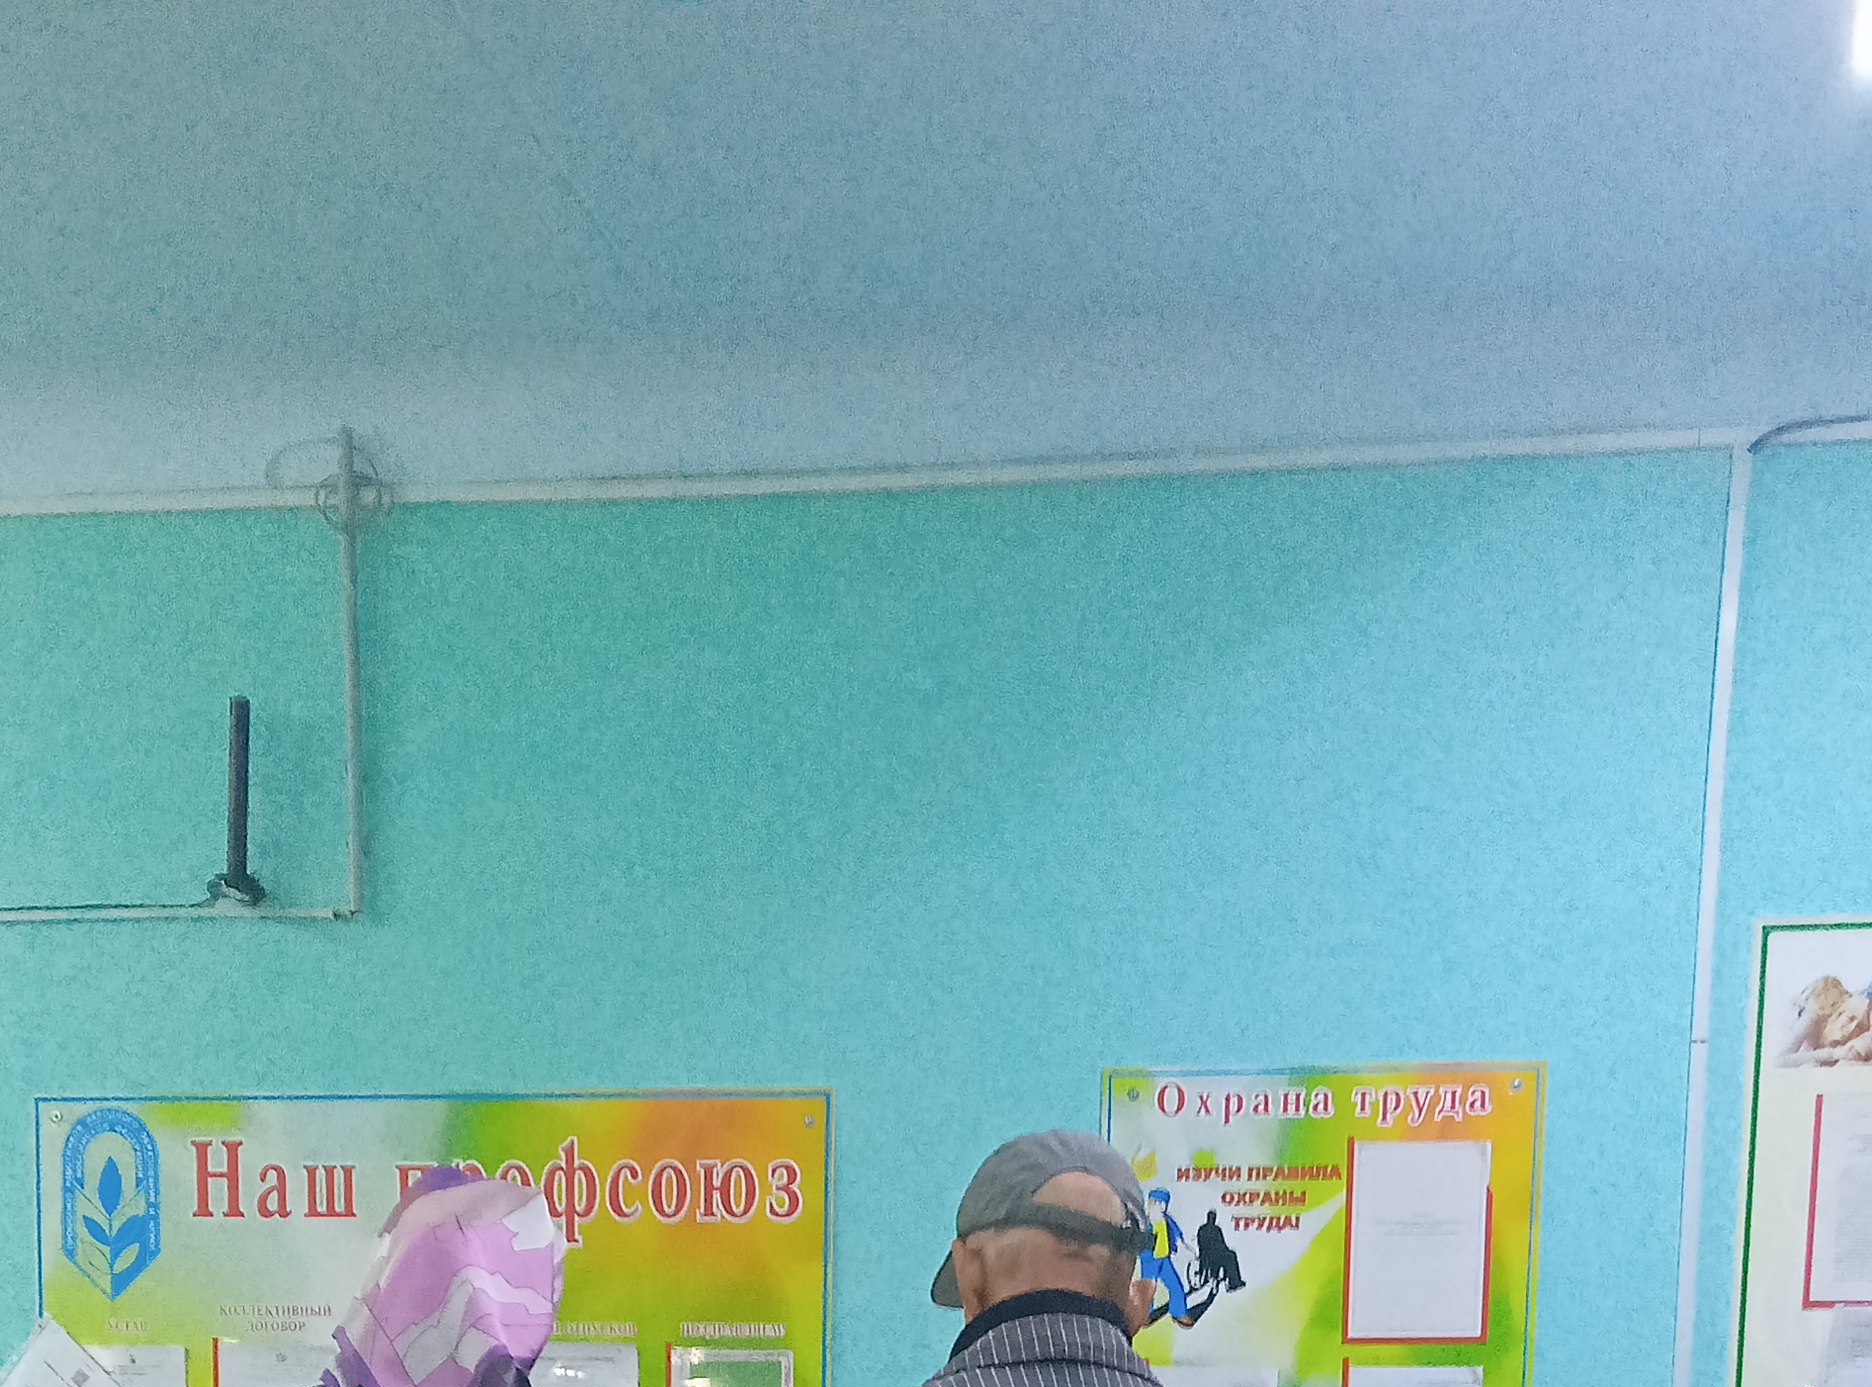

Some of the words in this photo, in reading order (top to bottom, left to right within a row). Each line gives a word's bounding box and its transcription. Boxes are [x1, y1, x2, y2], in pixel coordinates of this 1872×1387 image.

[1155, 1081, 1334, 1125] Охрана
[1351, 1081, 1493, 1127] труда
[1176, 1165, 1242, 1182] ИЗУЧИ
[1247, 1164, 1342, 1182] ПРАВИЛА
[191, 1138, 359, 1220] Наш
[395, 1135, 804, 1248] фсоюз
[1221, 1190, 1307, 1206] ОХРАНЫ
[1230, 1215, 1301, 1233] ТРУДА!
[219, 1304, 333, 1318] КОЛЛЕКТИВНЫЙ
[107, 1320, 148, 1333] УСТАВ
[245, 1320, 307, 1333] ДОГОВОР
